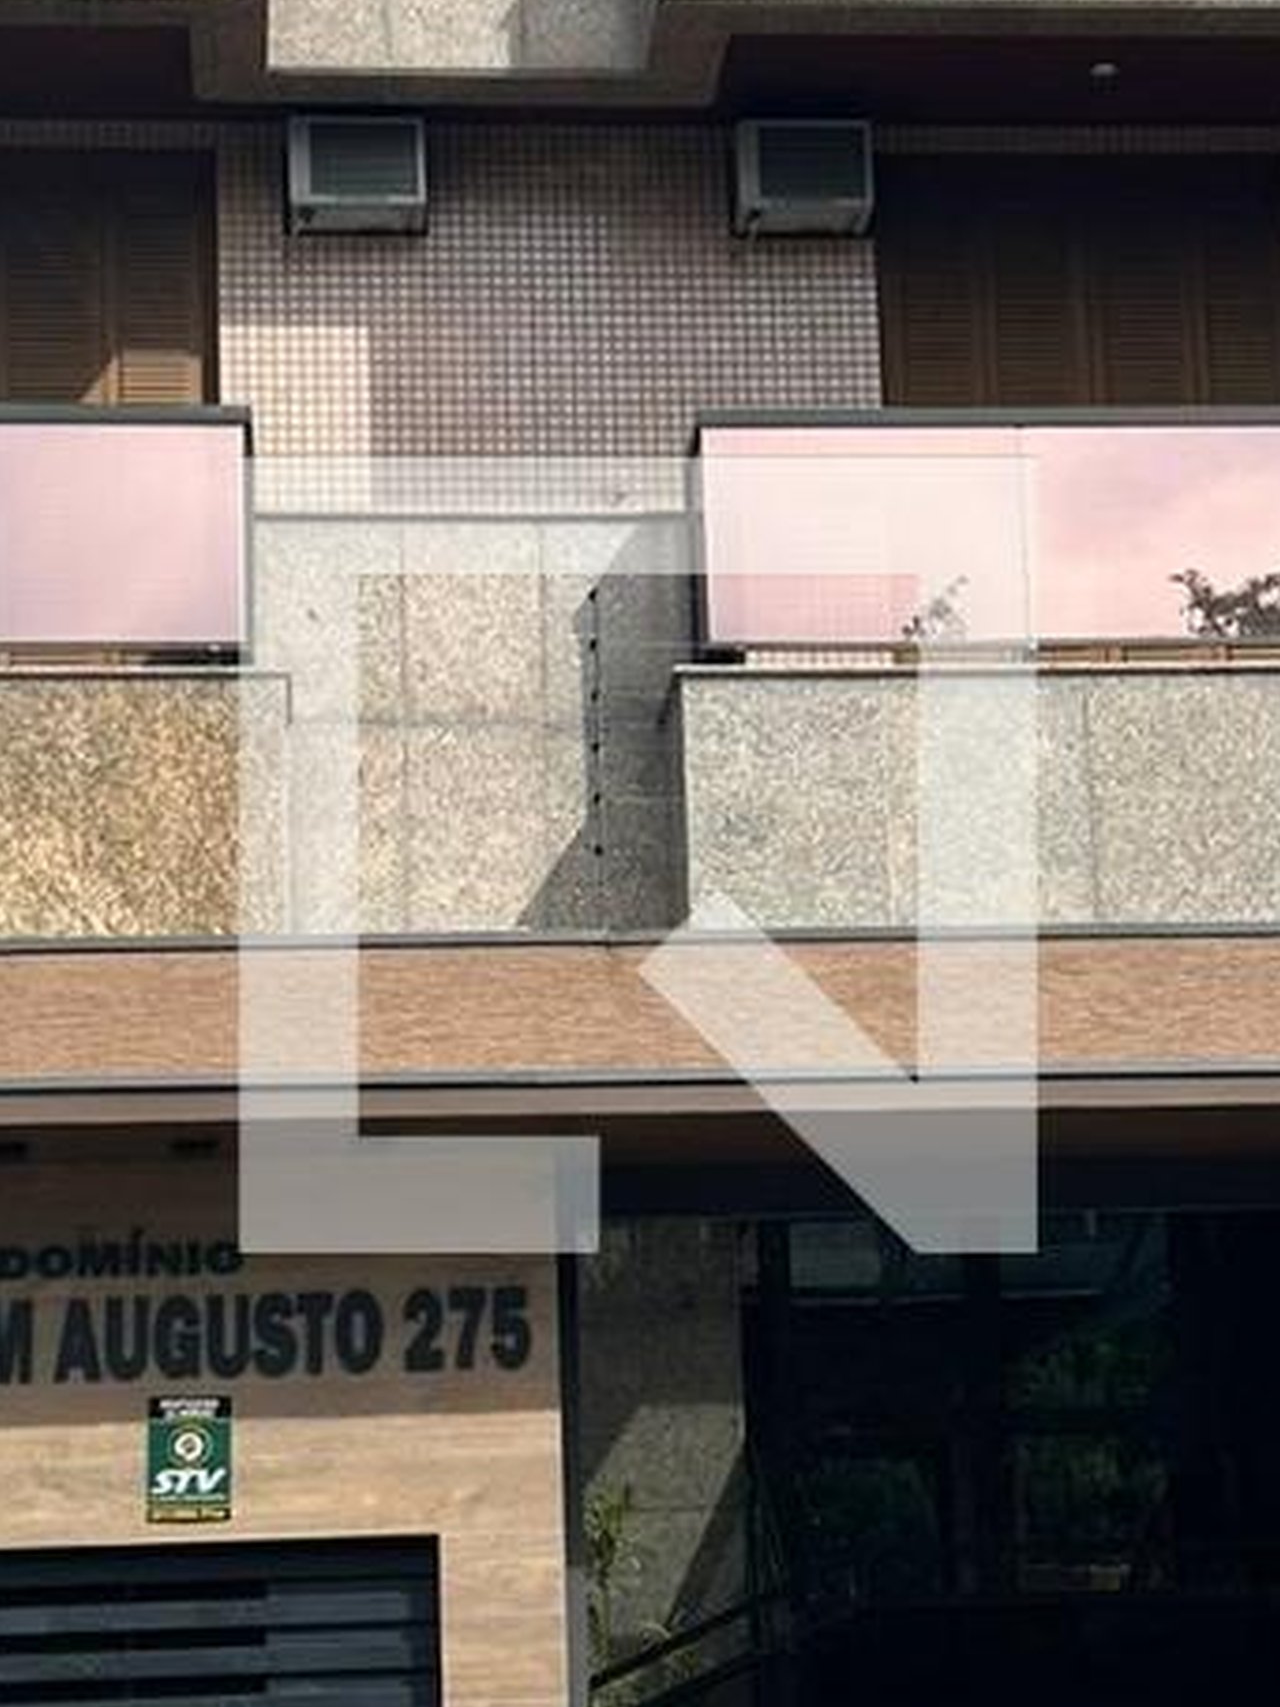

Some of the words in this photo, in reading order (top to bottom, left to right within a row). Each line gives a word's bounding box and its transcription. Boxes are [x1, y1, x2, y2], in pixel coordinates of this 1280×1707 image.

[53, 1289, 384, 1384] AUGUSTO
[404, 1284, 532, 1374] 275
[151, 1468, 226, 1494] STV
